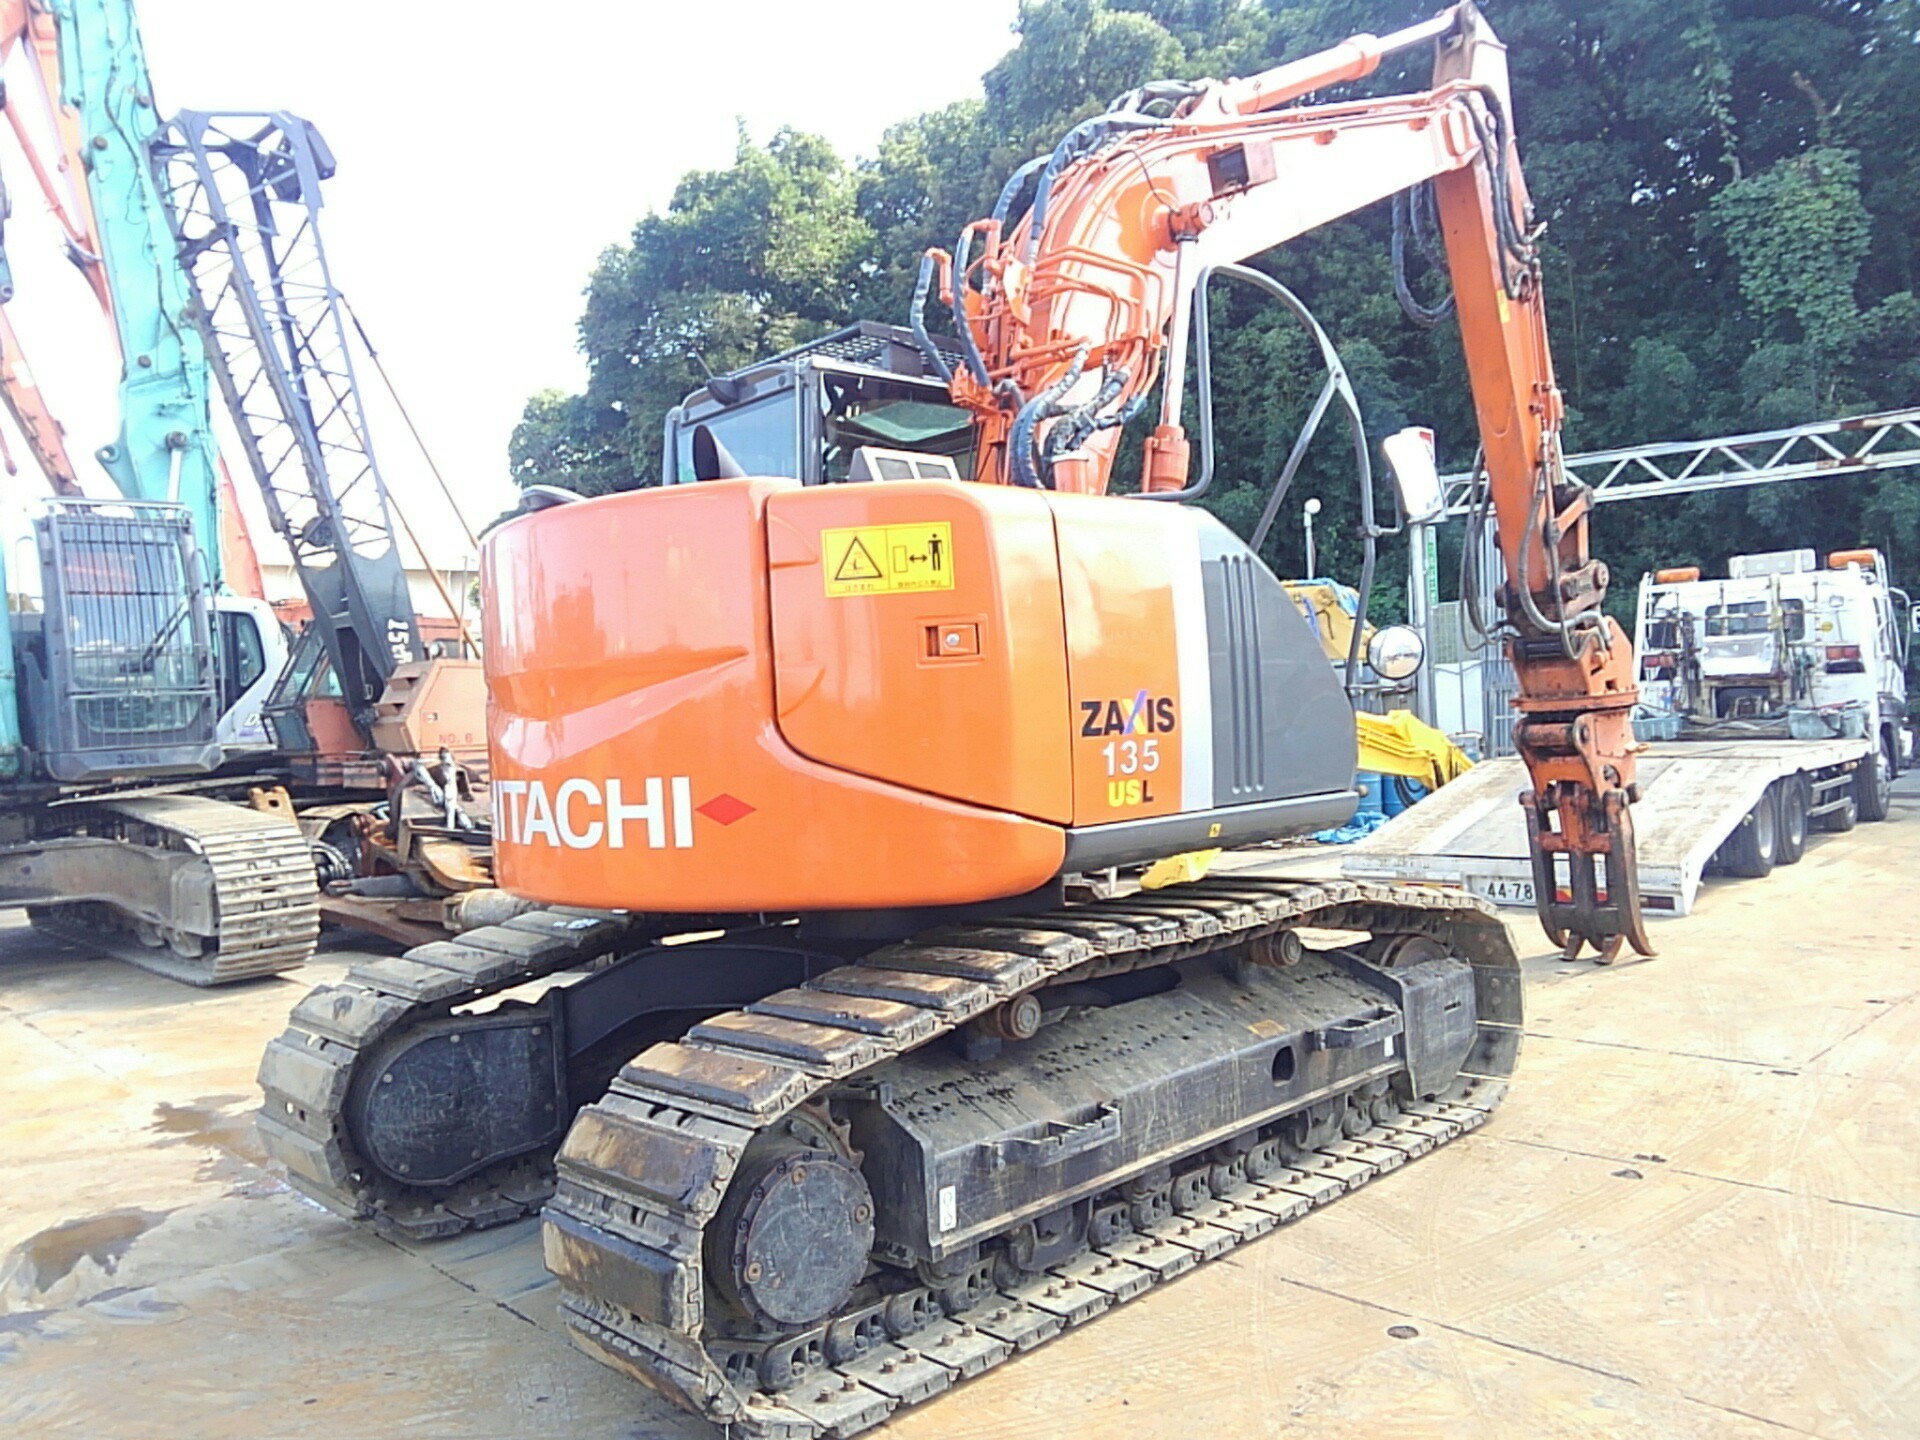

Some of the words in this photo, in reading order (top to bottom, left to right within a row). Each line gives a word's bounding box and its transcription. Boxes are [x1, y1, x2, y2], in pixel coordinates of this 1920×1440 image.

[1081, 690, 1175, 737] ZAXIS
[1102, 739, 1160, 777] 135
[1108, 779, 1154, 807] USL
[1487, 882, 1533, 900] 44-78
